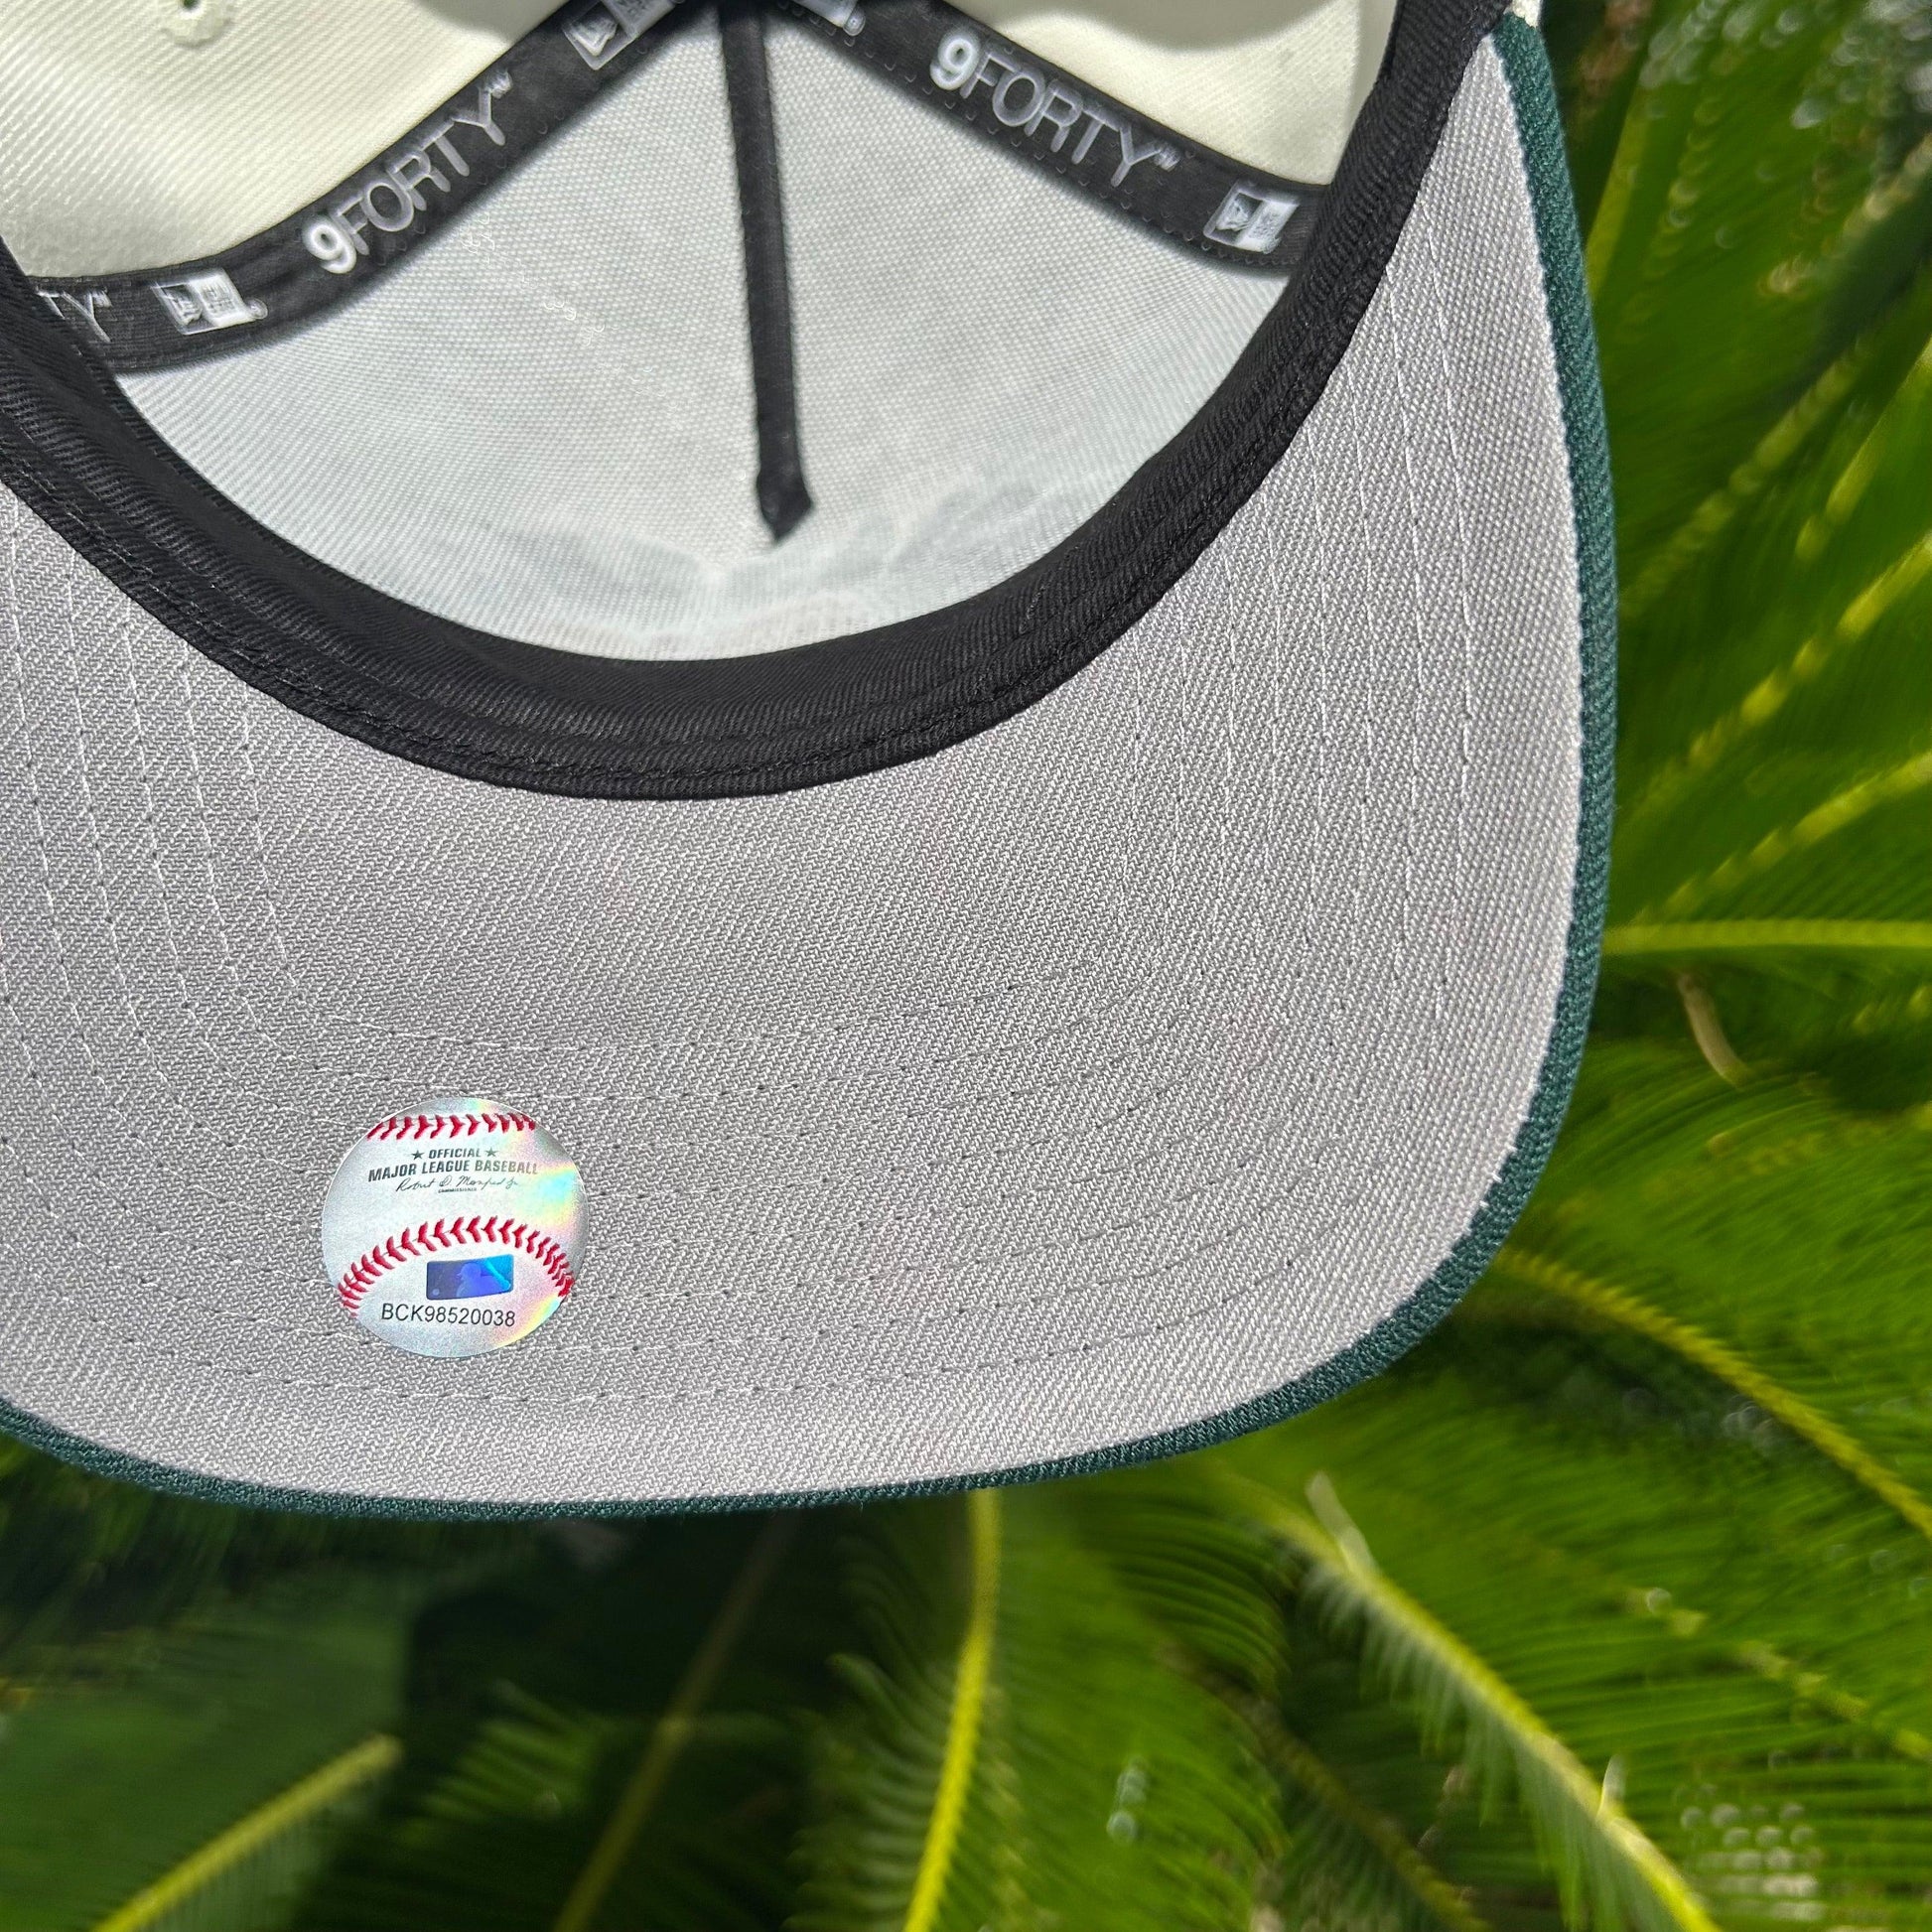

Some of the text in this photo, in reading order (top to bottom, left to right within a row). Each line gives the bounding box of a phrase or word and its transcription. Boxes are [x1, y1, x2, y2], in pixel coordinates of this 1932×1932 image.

[428, 1148, 482, 1160] OFFICIAL
[367, 1160, 538, 1182] MAJOR LEAGUE BASEBALL
[381, 1303, 515, 1327] BCK98520038
